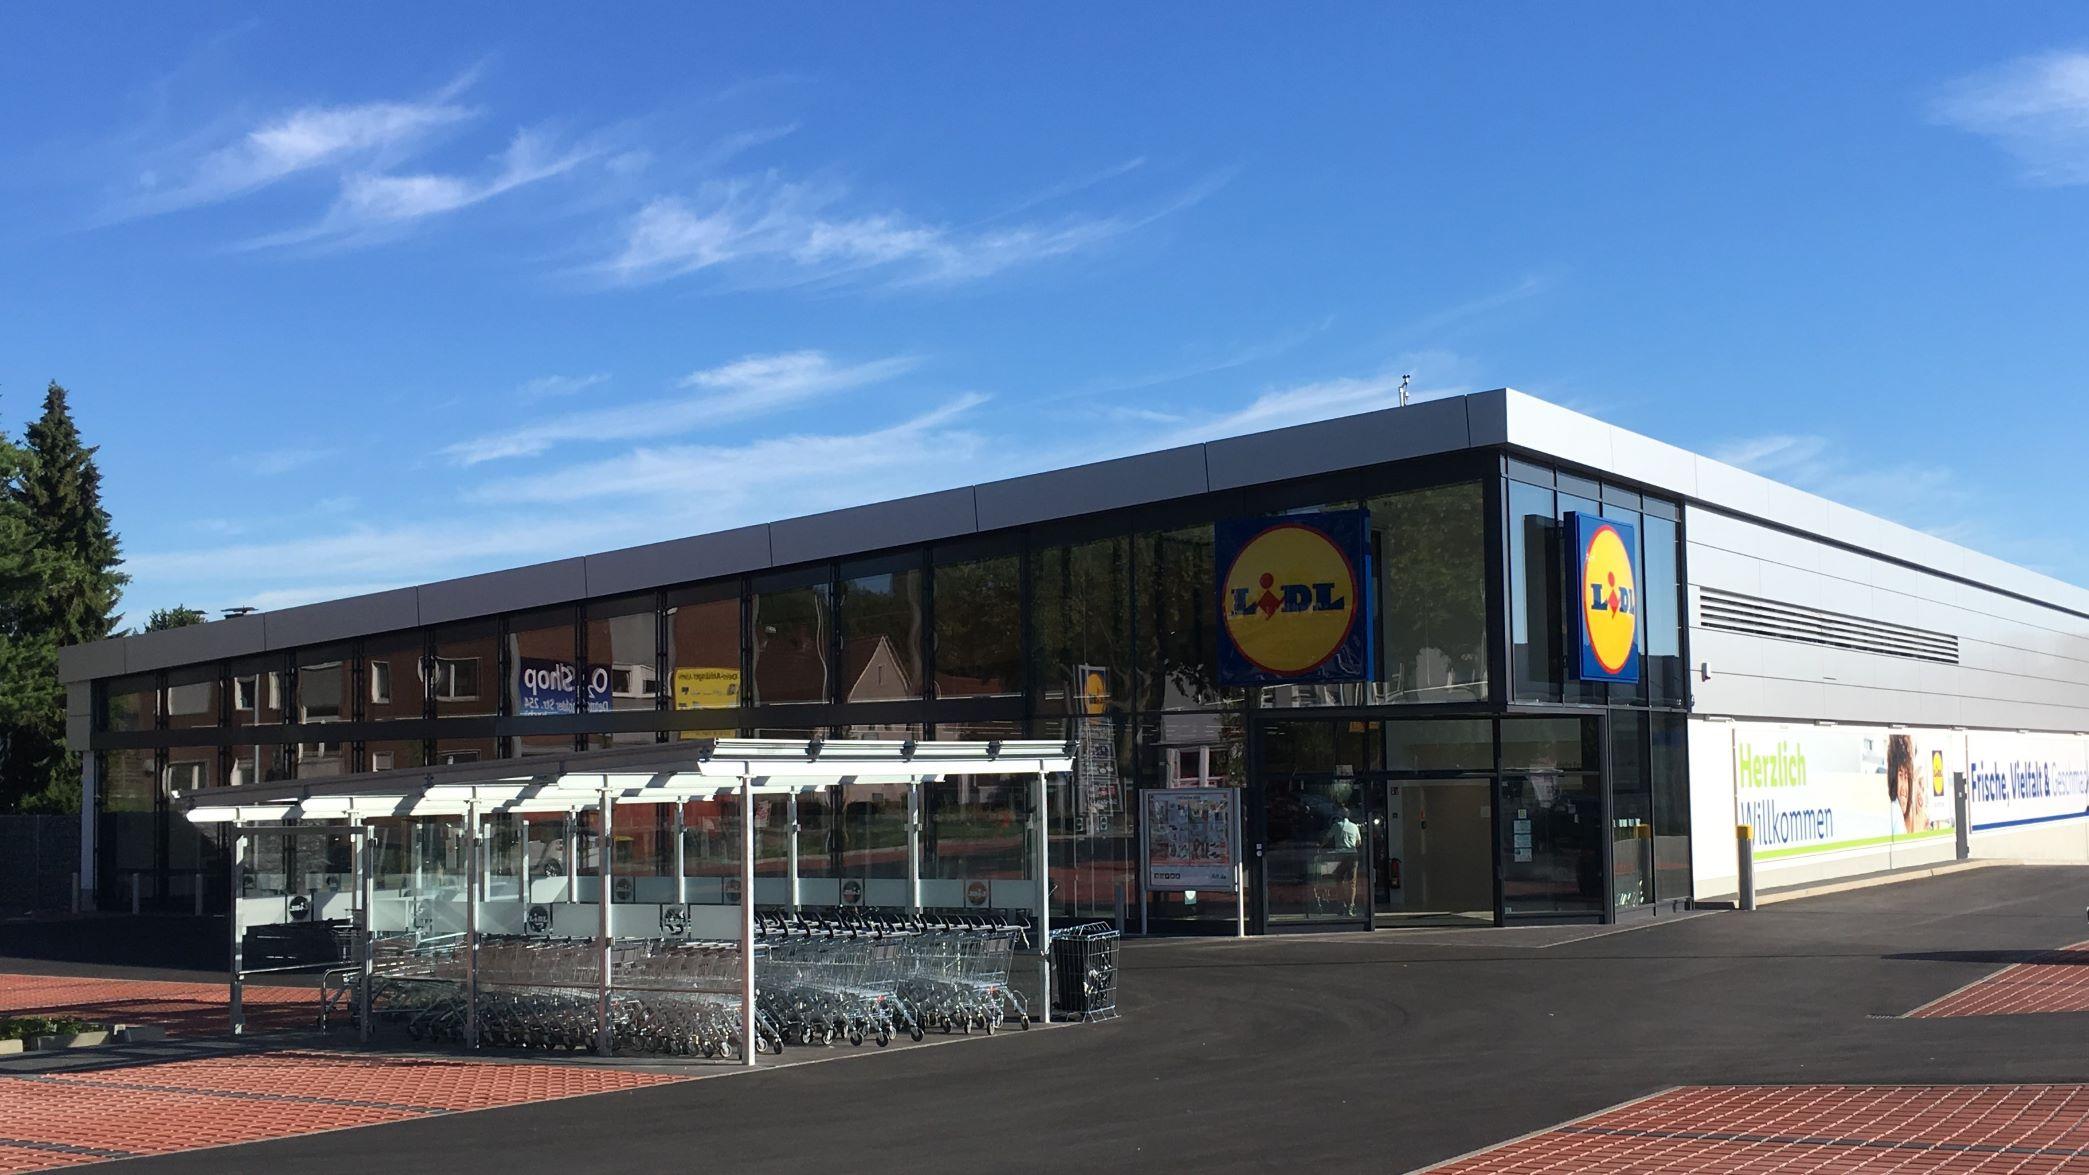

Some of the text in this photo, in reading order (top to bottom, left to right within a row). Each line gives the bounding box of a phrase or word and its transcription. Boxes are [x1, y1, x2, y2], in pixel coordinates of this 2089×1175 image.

[1739, 741, 1807, 788] Herzlich
[1971, 760, 2010, 807] Frische,
[2010, 760, 2043, 799] Vielfalt
[2043, 761, 2051, 798] &
[1741, 798, 1834, 846] Willkommen
